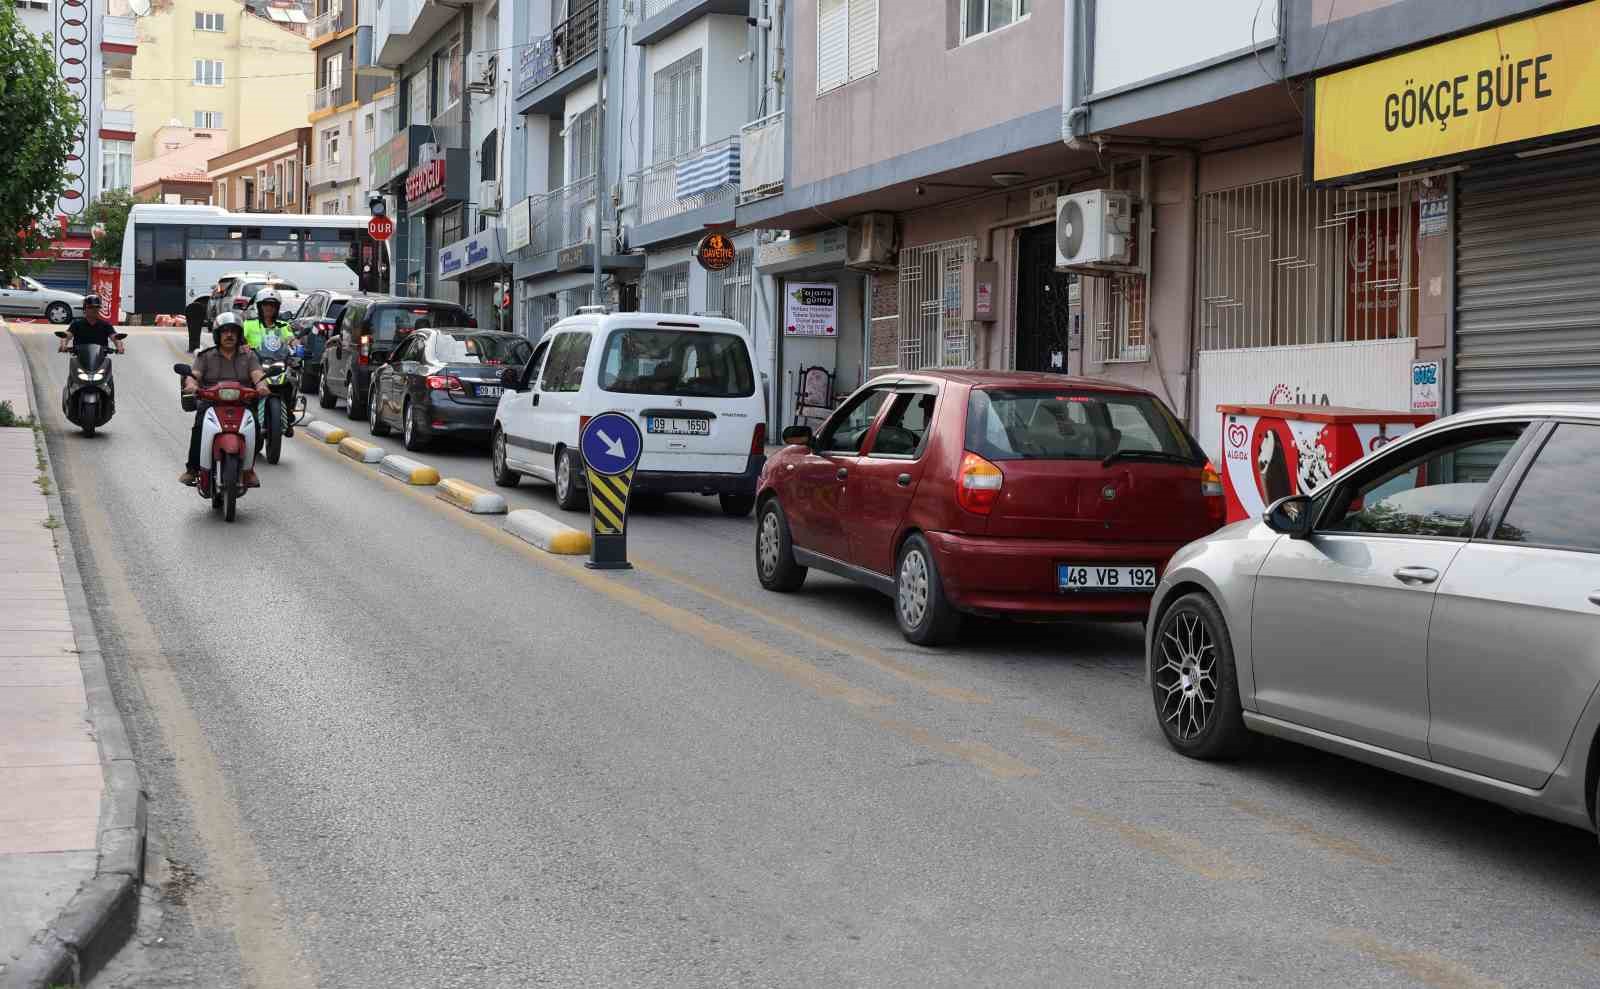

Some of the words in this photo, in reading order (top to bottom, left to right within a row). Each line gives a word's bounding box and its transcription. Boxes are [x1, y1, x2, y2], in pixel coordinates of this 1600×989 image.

[1385, 75, 1468, 131] GÖKÇE
[1477, 54, 1552, 112] BÜFE
[370, 223, 392, 233] DUR
[654, 419, 665, 430] 09
[672, 419, 679, 430] L
[688, 419, 707, 432] 1650
[1068, 568, 1087, 585] 48
[1096, 568, 1119, 585] VB
[1129, 568, 1154, 585] 192
